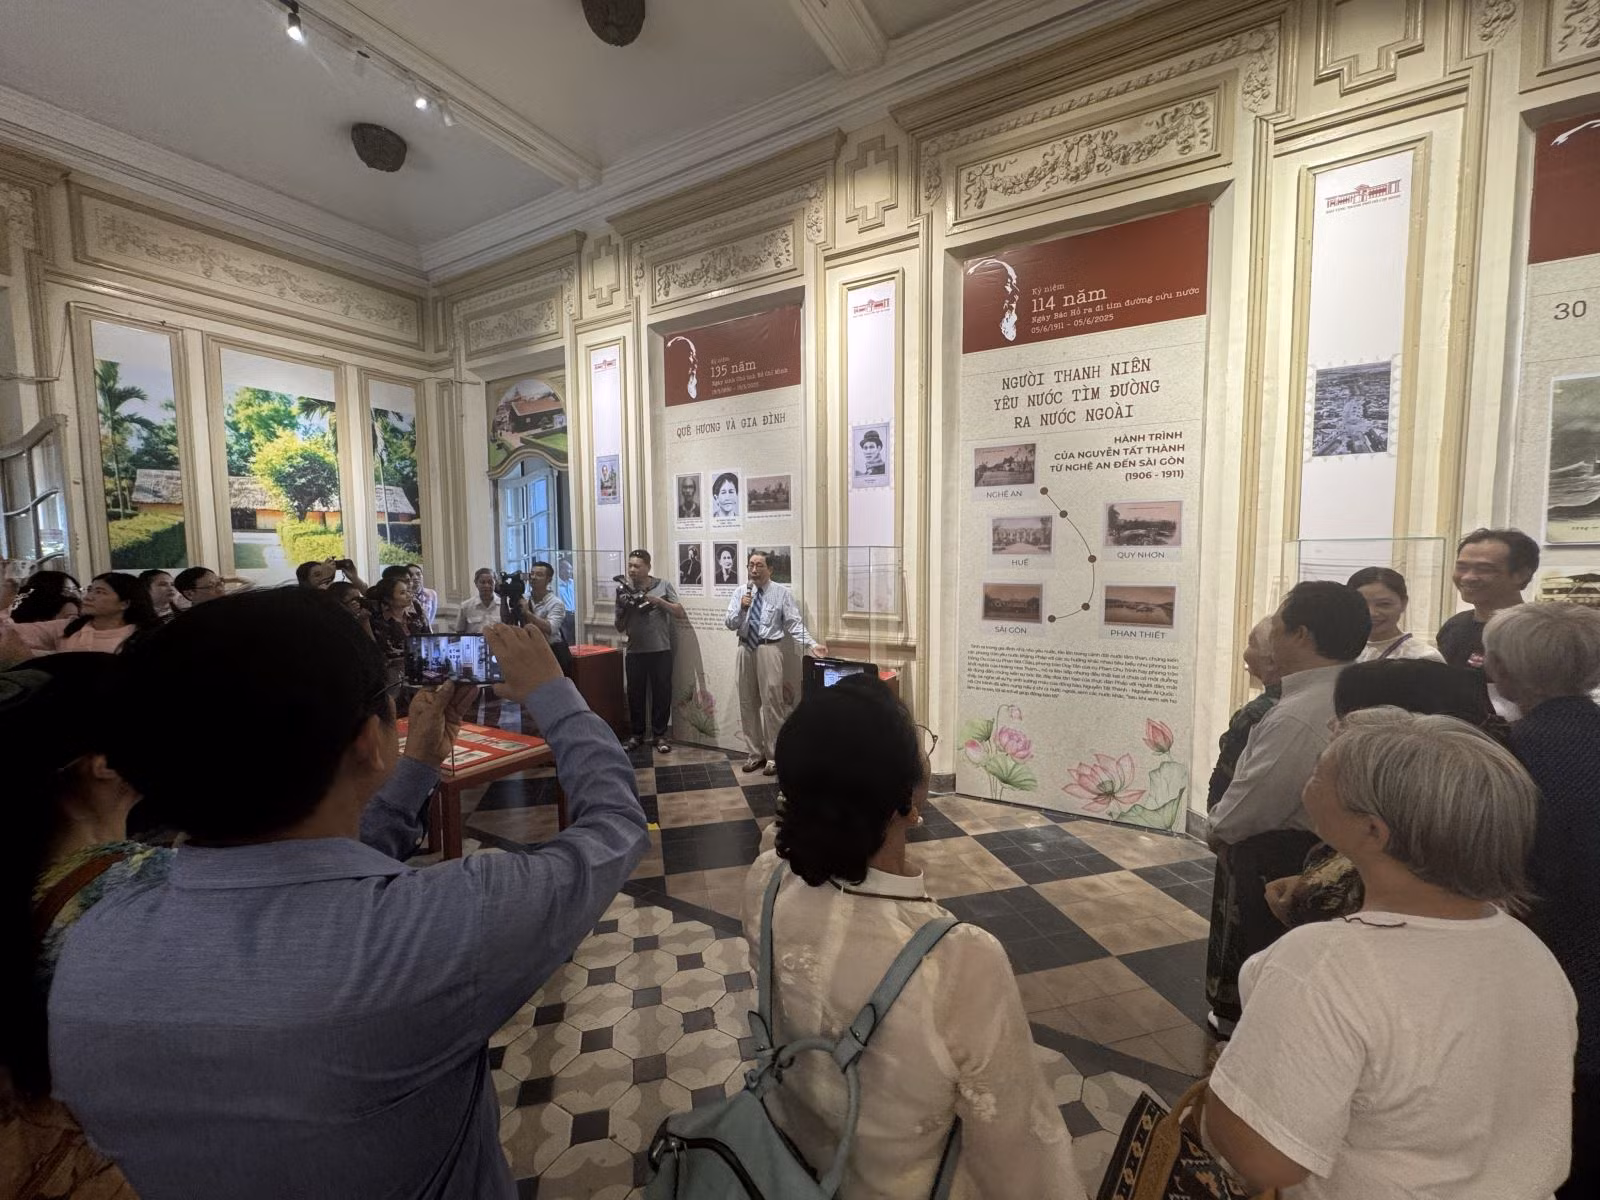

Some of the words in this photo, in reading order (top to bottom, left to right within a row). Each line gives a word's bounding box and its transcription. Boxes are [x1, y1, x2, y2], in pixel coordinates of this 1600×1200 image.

[1031, 295, 1056, 313] 114
[1062, 288, 1108, 307] năm
[1095, 304, 1104, 312] đi
[1124, 296, 1154, 307] đường
[1175, 287, 1200, 298] nước
[1553, 300, 1587, 320] 30
[1031, 322, 1065, 334] 05/6/1911
[1073, 313, 1114, 327] 05/6/2025
[710, 364, 728, 378] 135
[730, 360, 756, 374] năm
[1001, 370, 1045, 391] NGƯỜI
[1053, 365, 1101, 383] THANH
[1110, 356, 1152, 376] NIÊN
[993, 395, 1019, 411] YÊU
[1027, 389, 1063, 407] NƯỚC
[1071, 385, 1101, 402] TÌM
[1110, 378, 1160, 398] ĐƯỜNG
[676, 424, 692, 439] QUÊ
[695, 422, 721, 435] HƯƠNG
[725, 417, 736, 430] VÀ
[740, 417, 758, 429] GIA
[762, 411, 786, 426] ĐÌNH
[1014, 416, 1031, 429] RA
[1039, 408, 1076, 426] NƯỚC
[1085, 402, 1134, 422] NGOÀI
[1113, 434, 1146, 444] HÀNH
[1148, 431, 1183, 441] TRÌNH
[1054, 450, 1075, 460] CỦA
[1077, 446, 1121, 458] NGUYỄN
[1123, 445, 1143, 456] TẤT
[1145, 444, 1185, 454] THÀNH
[1049, 463, 1063, 472] TỪ
[1065, 461, 1093, 472] NGHỆ
[1095, 461, 1111, 470] AN
[1113, 458, 1136, 469] ĐẾN
[1139, 457, 1157, 467] SÀI
[1159, 456, 1185, 466] GÒN
[1125, 471, 1152, 482] (1906
[1161, 469, 1184, 479] 1911)
[1116, 551, 1136, 559] QUY
[1110, 629, 1137, 638] PHAN
[1139, 630, 1166, 639] THIẾT
